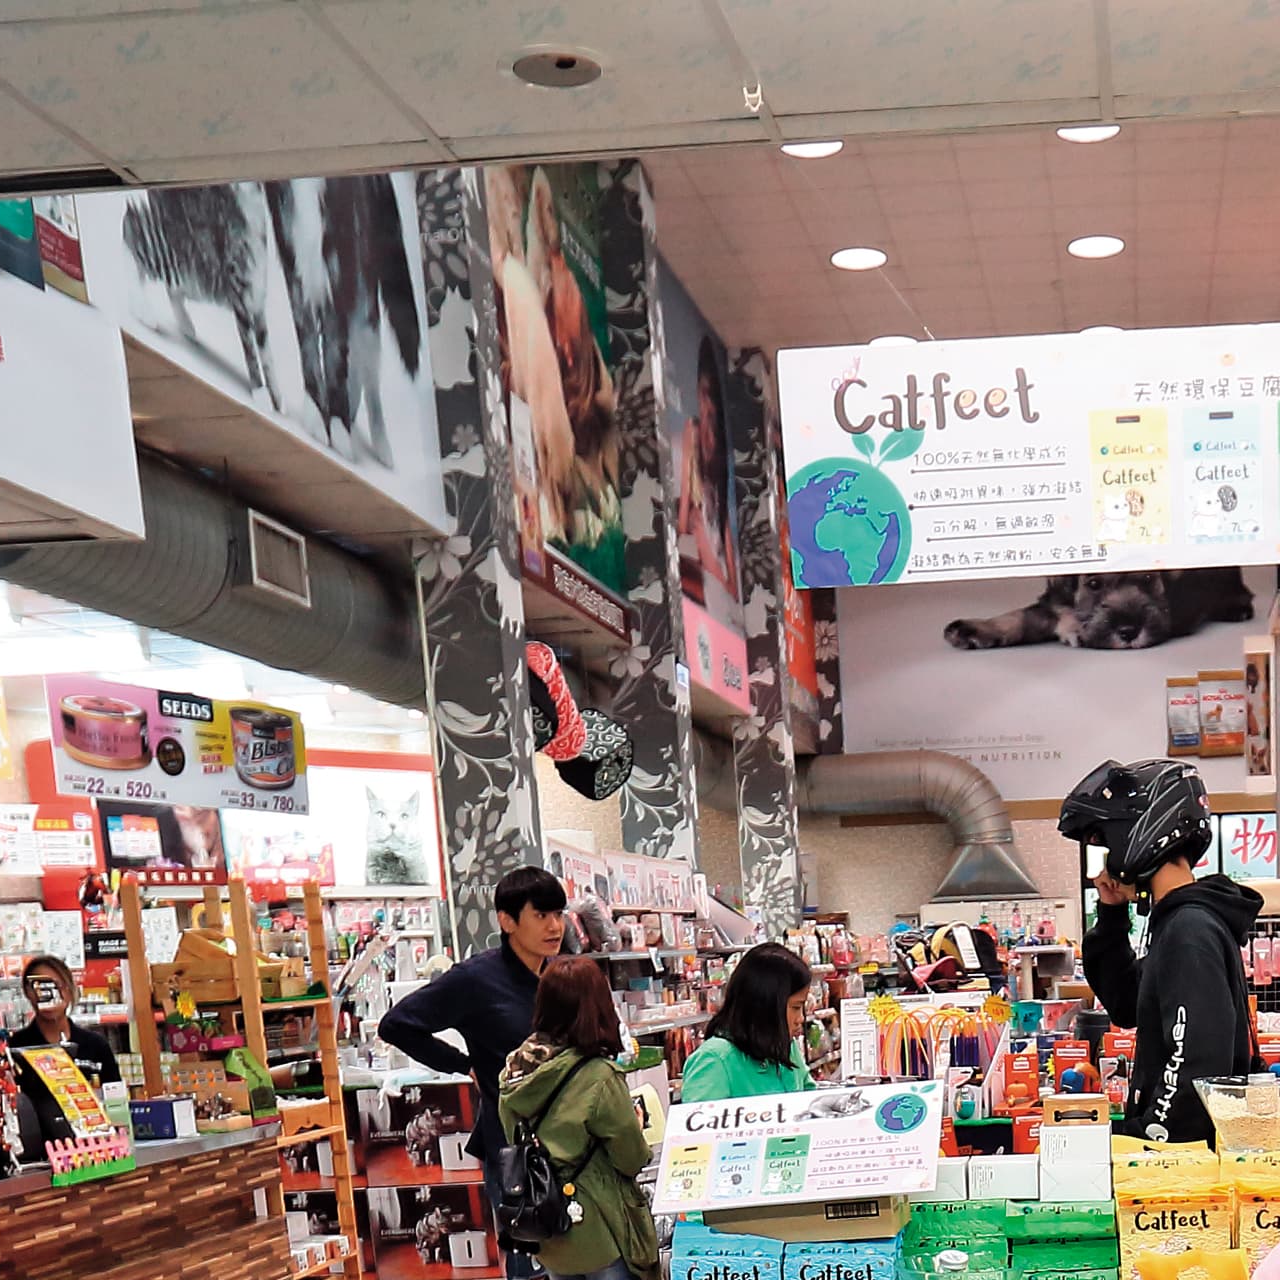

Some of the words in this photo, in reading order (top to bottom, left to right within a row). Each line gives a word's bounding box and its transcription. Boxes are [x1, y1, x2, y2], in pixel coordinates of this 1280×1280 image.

[833, 366, 1041, 437] Catfeet
[161, 698, 212, 720] SEEDS
[982, 750, 1064, 762] NUTRITION
[87, 776, 106, 795] 22
[126, 781, 152, 799] 520
[240, 791, 256, 809] 33
[272, 796, 295, 812] 780
[1231, 816, 1278, 866] 物
[685, 1102, 787, 1133] Catfeet
[1134, 1209, 1211, 1232] Catfeet
